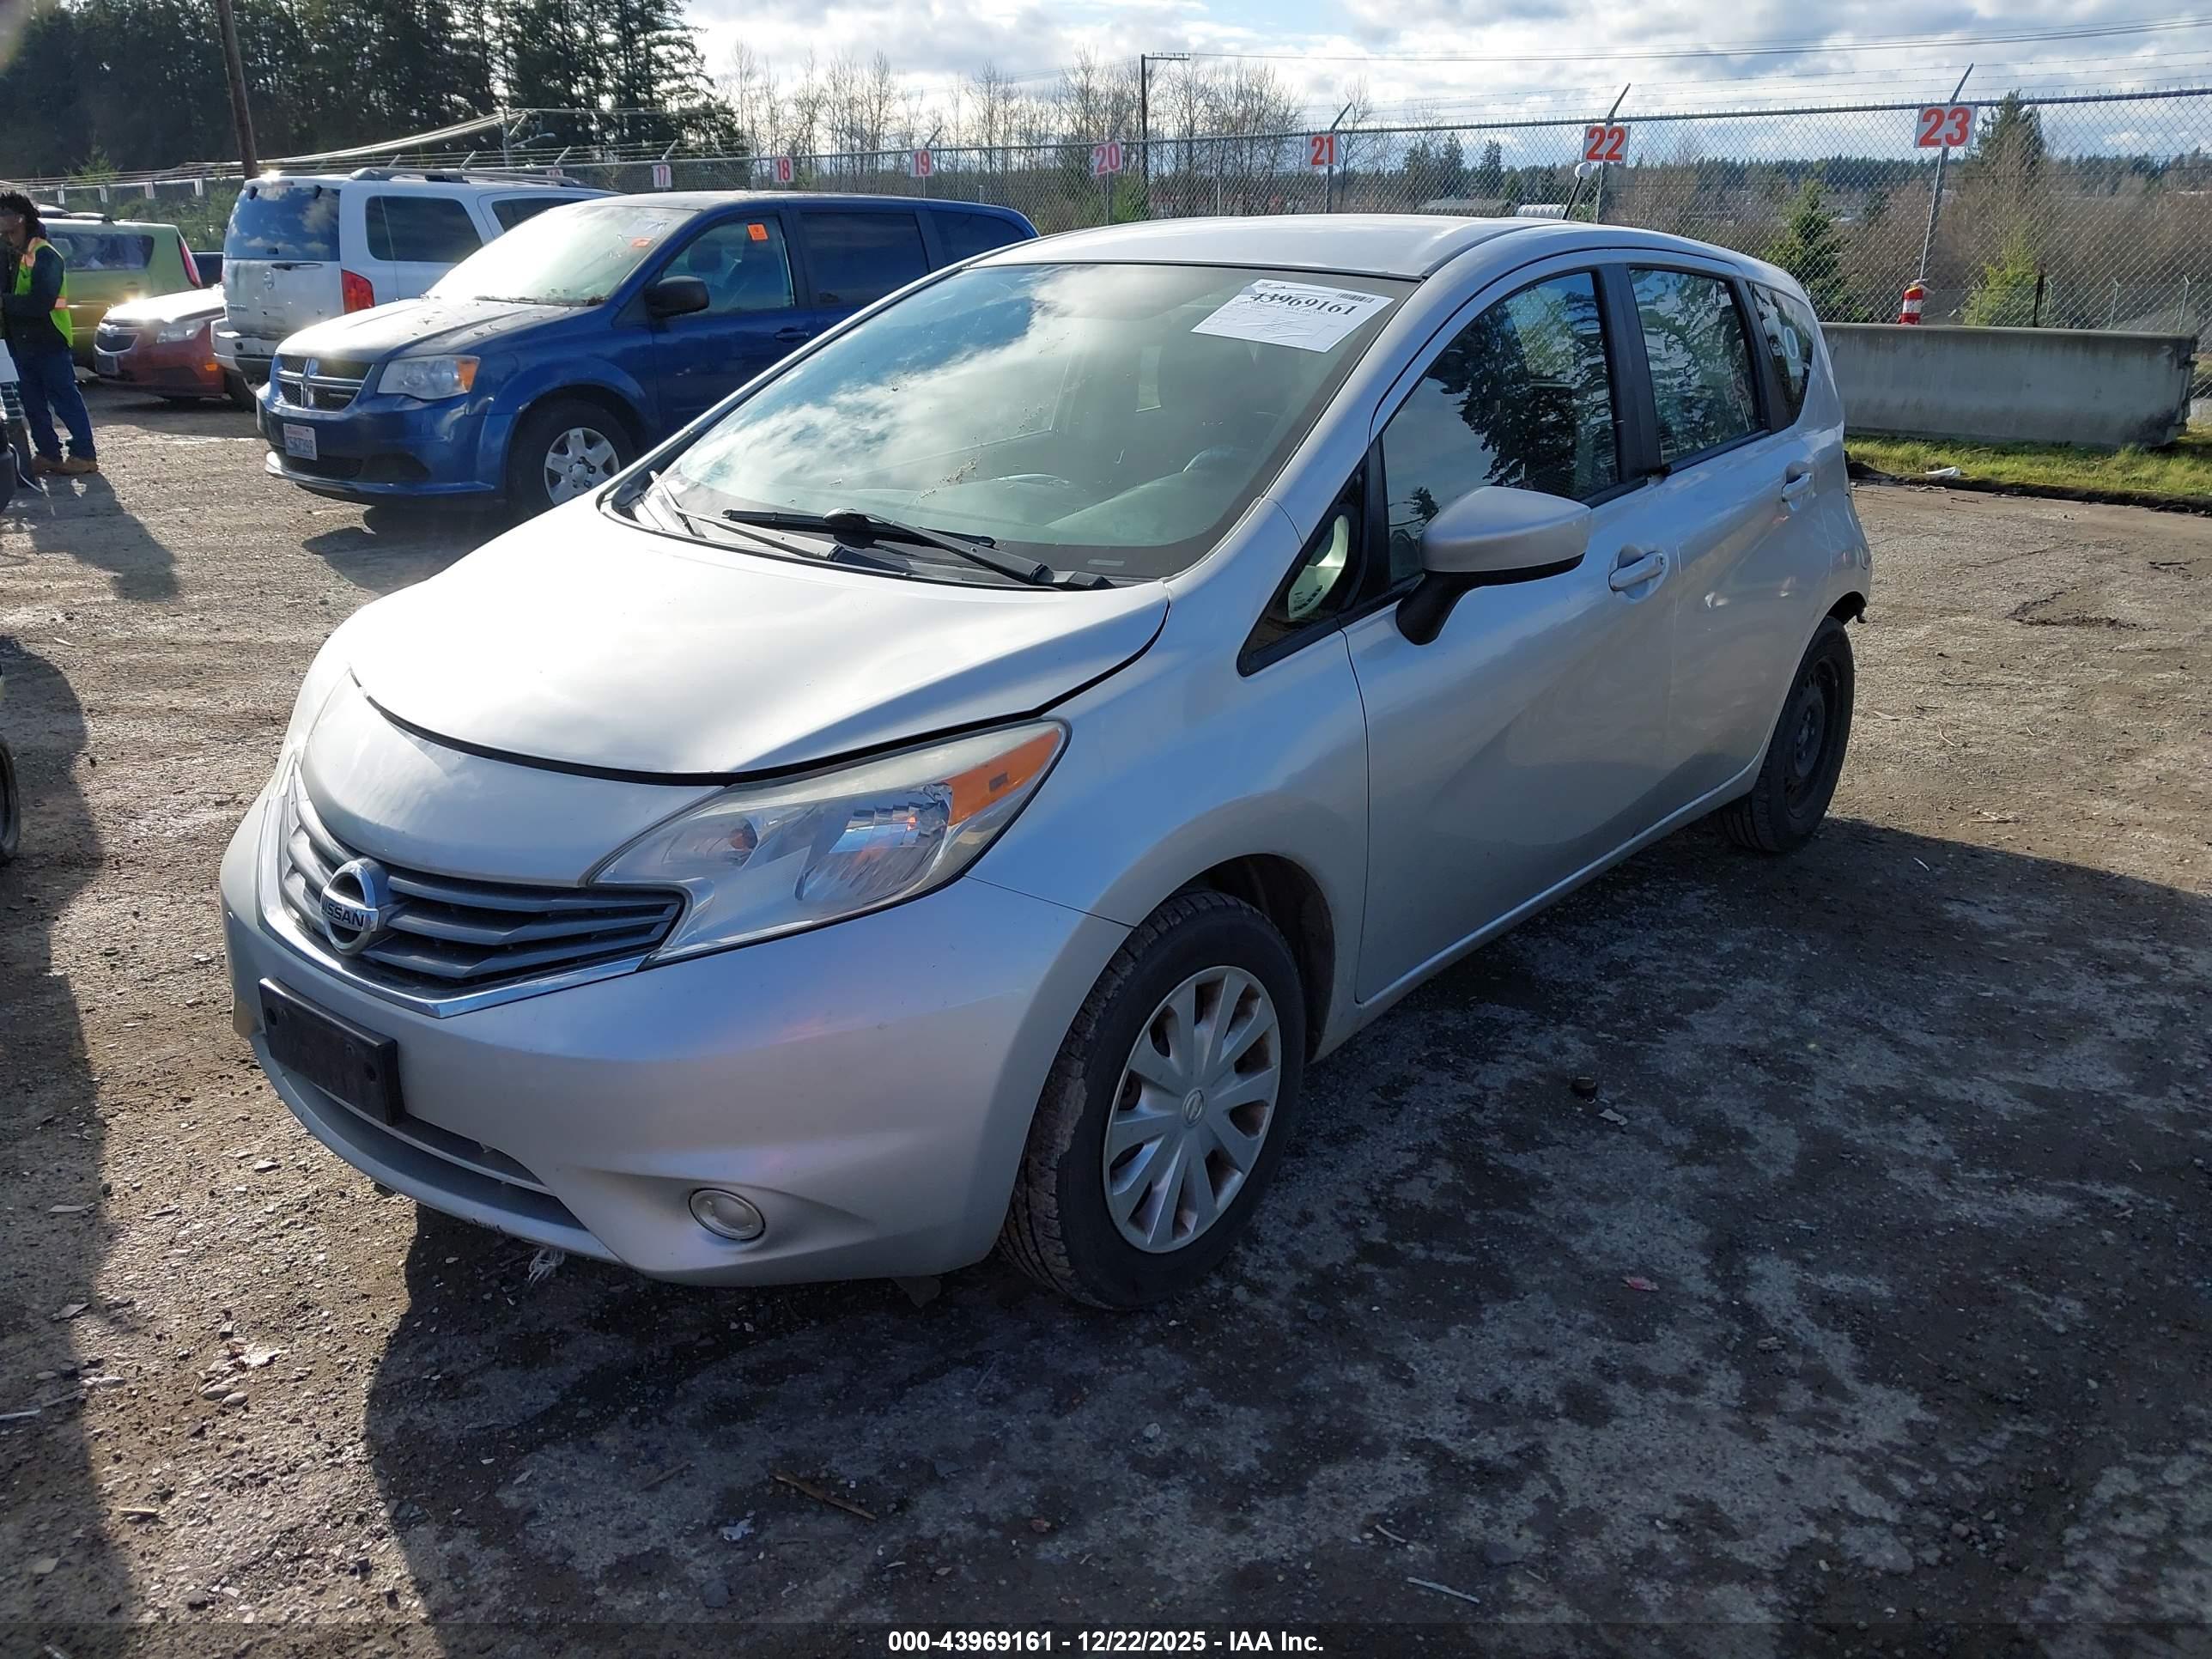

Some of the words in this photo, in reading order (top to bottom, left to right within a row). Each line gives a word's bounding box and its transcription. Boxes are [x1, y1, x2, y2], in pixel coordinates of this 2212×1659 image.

[1919, 106, 1972, 146] 23
[1095, 143, 1120, 173] 20
[1311, 135, 1334, 165] 21
[1586, 126, 1626, 161] 22
[658, 165, 668, 186] 17
[776, 157, 791, 180] 18
[913, 150, 930, 175] 19
[1250, 293, 1358, 315] 43969161
[321, 892, 364, 927] NISSAN
